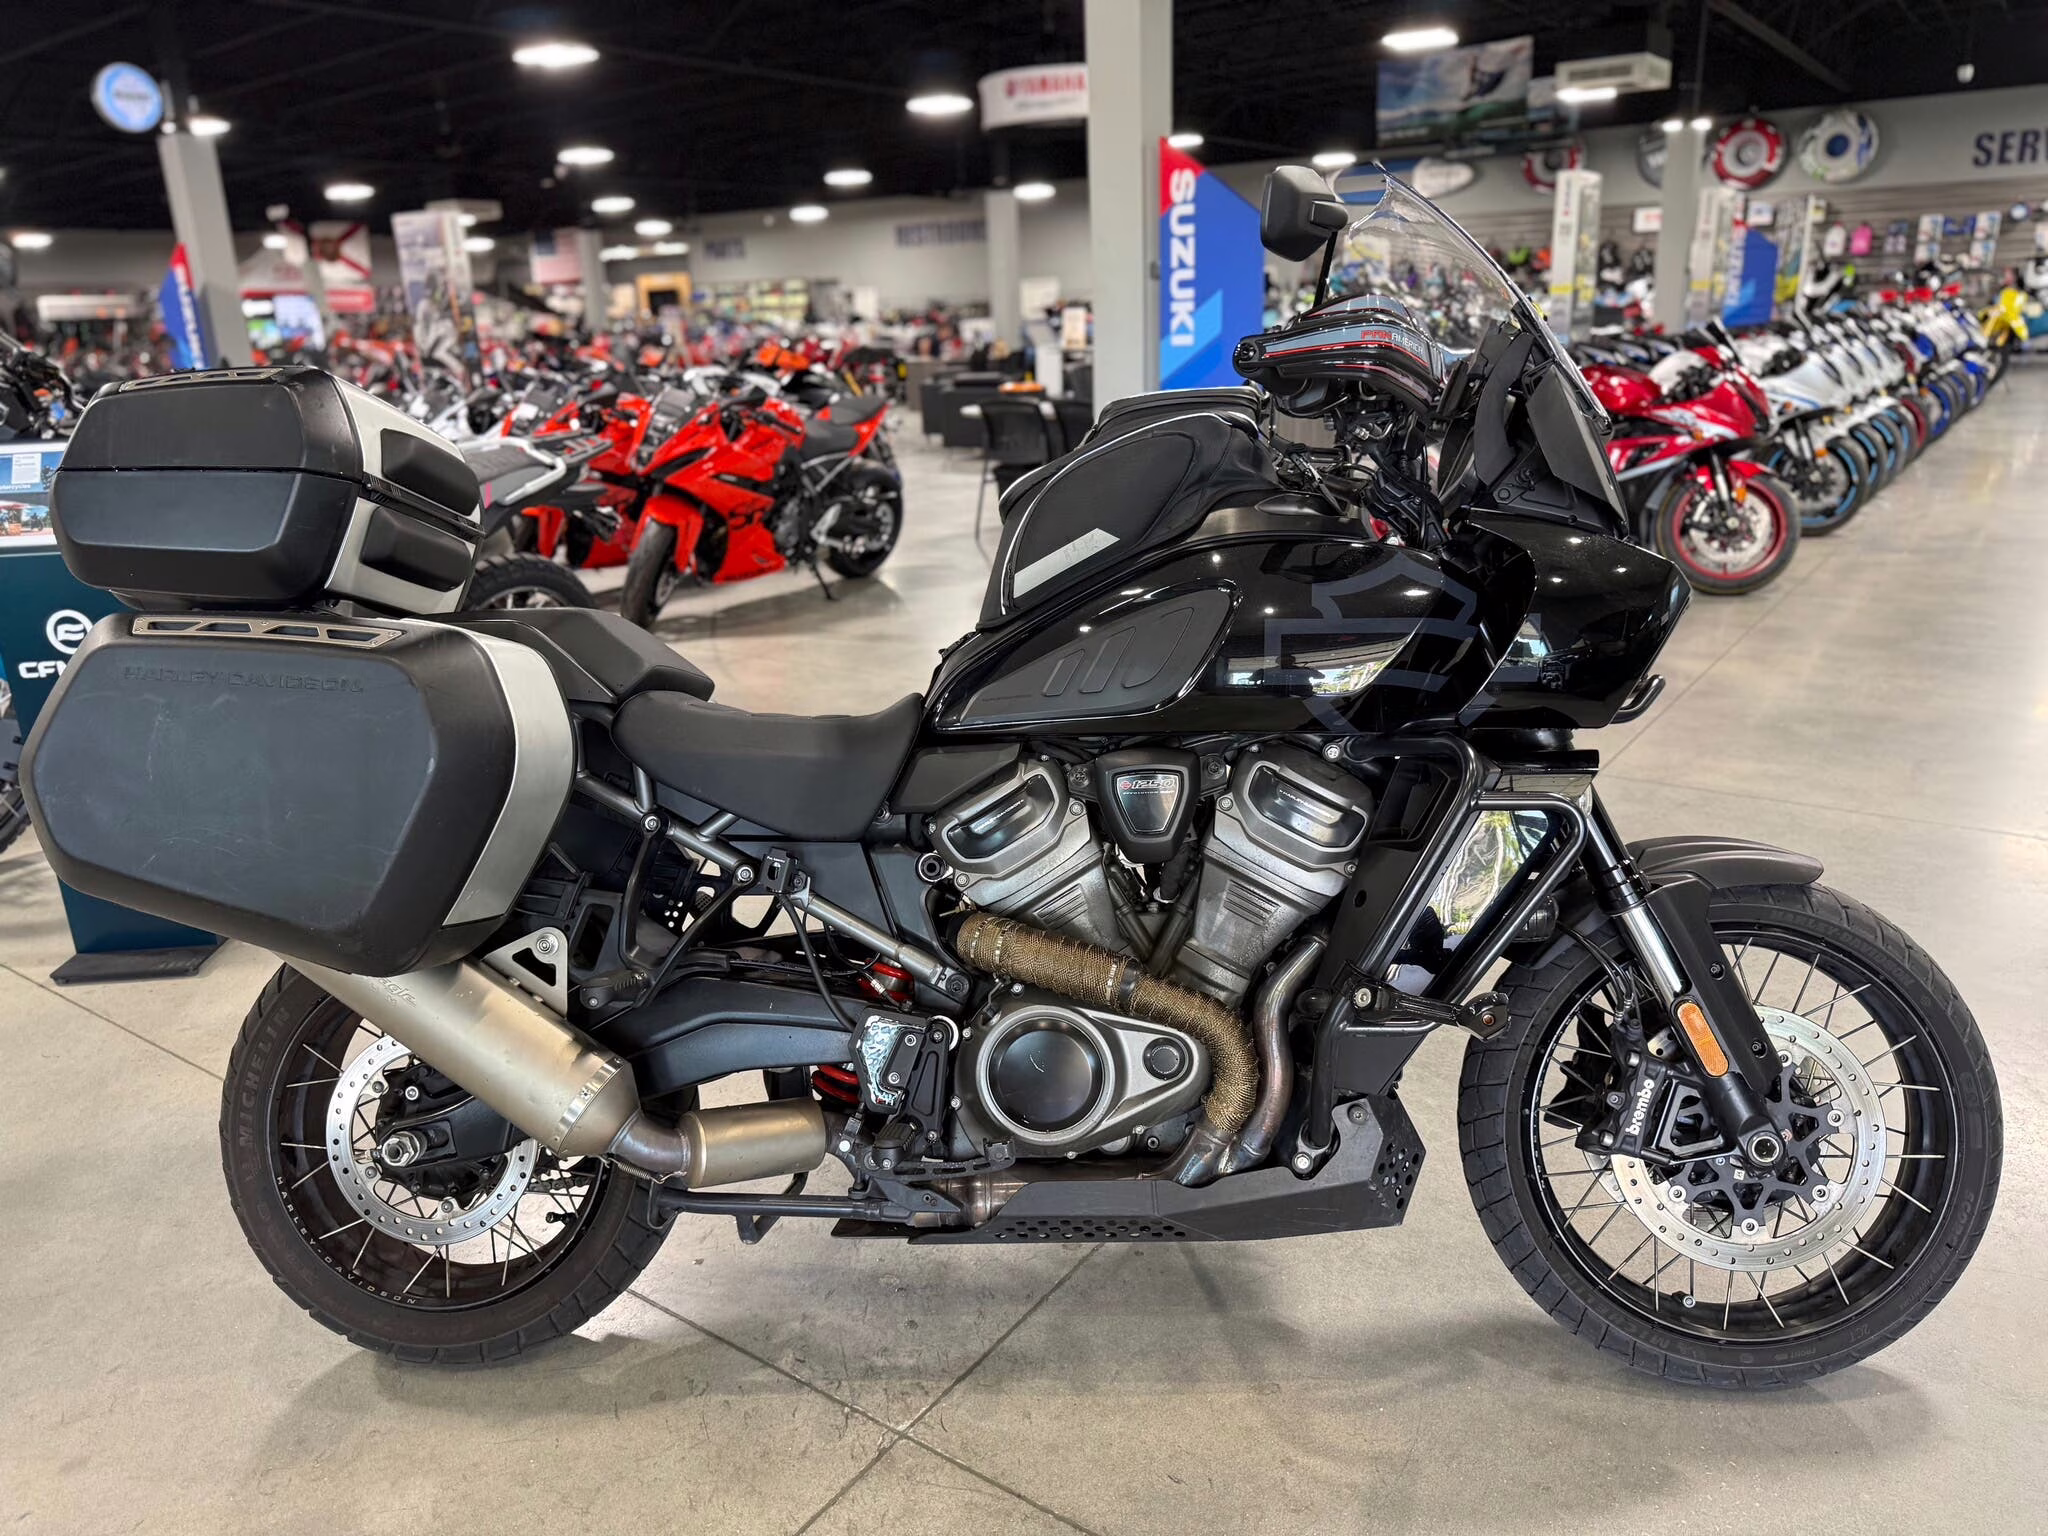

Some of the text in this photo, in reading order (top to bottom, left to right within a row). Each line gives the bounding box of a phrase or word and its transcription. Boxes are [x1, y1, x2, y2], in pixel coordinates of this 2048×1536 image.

[1169, 168, 1196, 347] SUZUKI
[1361, 329, 1425, 356] PAN AMERICA
[239, 1006, 292, 1147] MICHELIN
[1625, 1079, 1655, 1136] brembo
[276, 1176, 417, 1305] HARLEY-DAVIDSON
